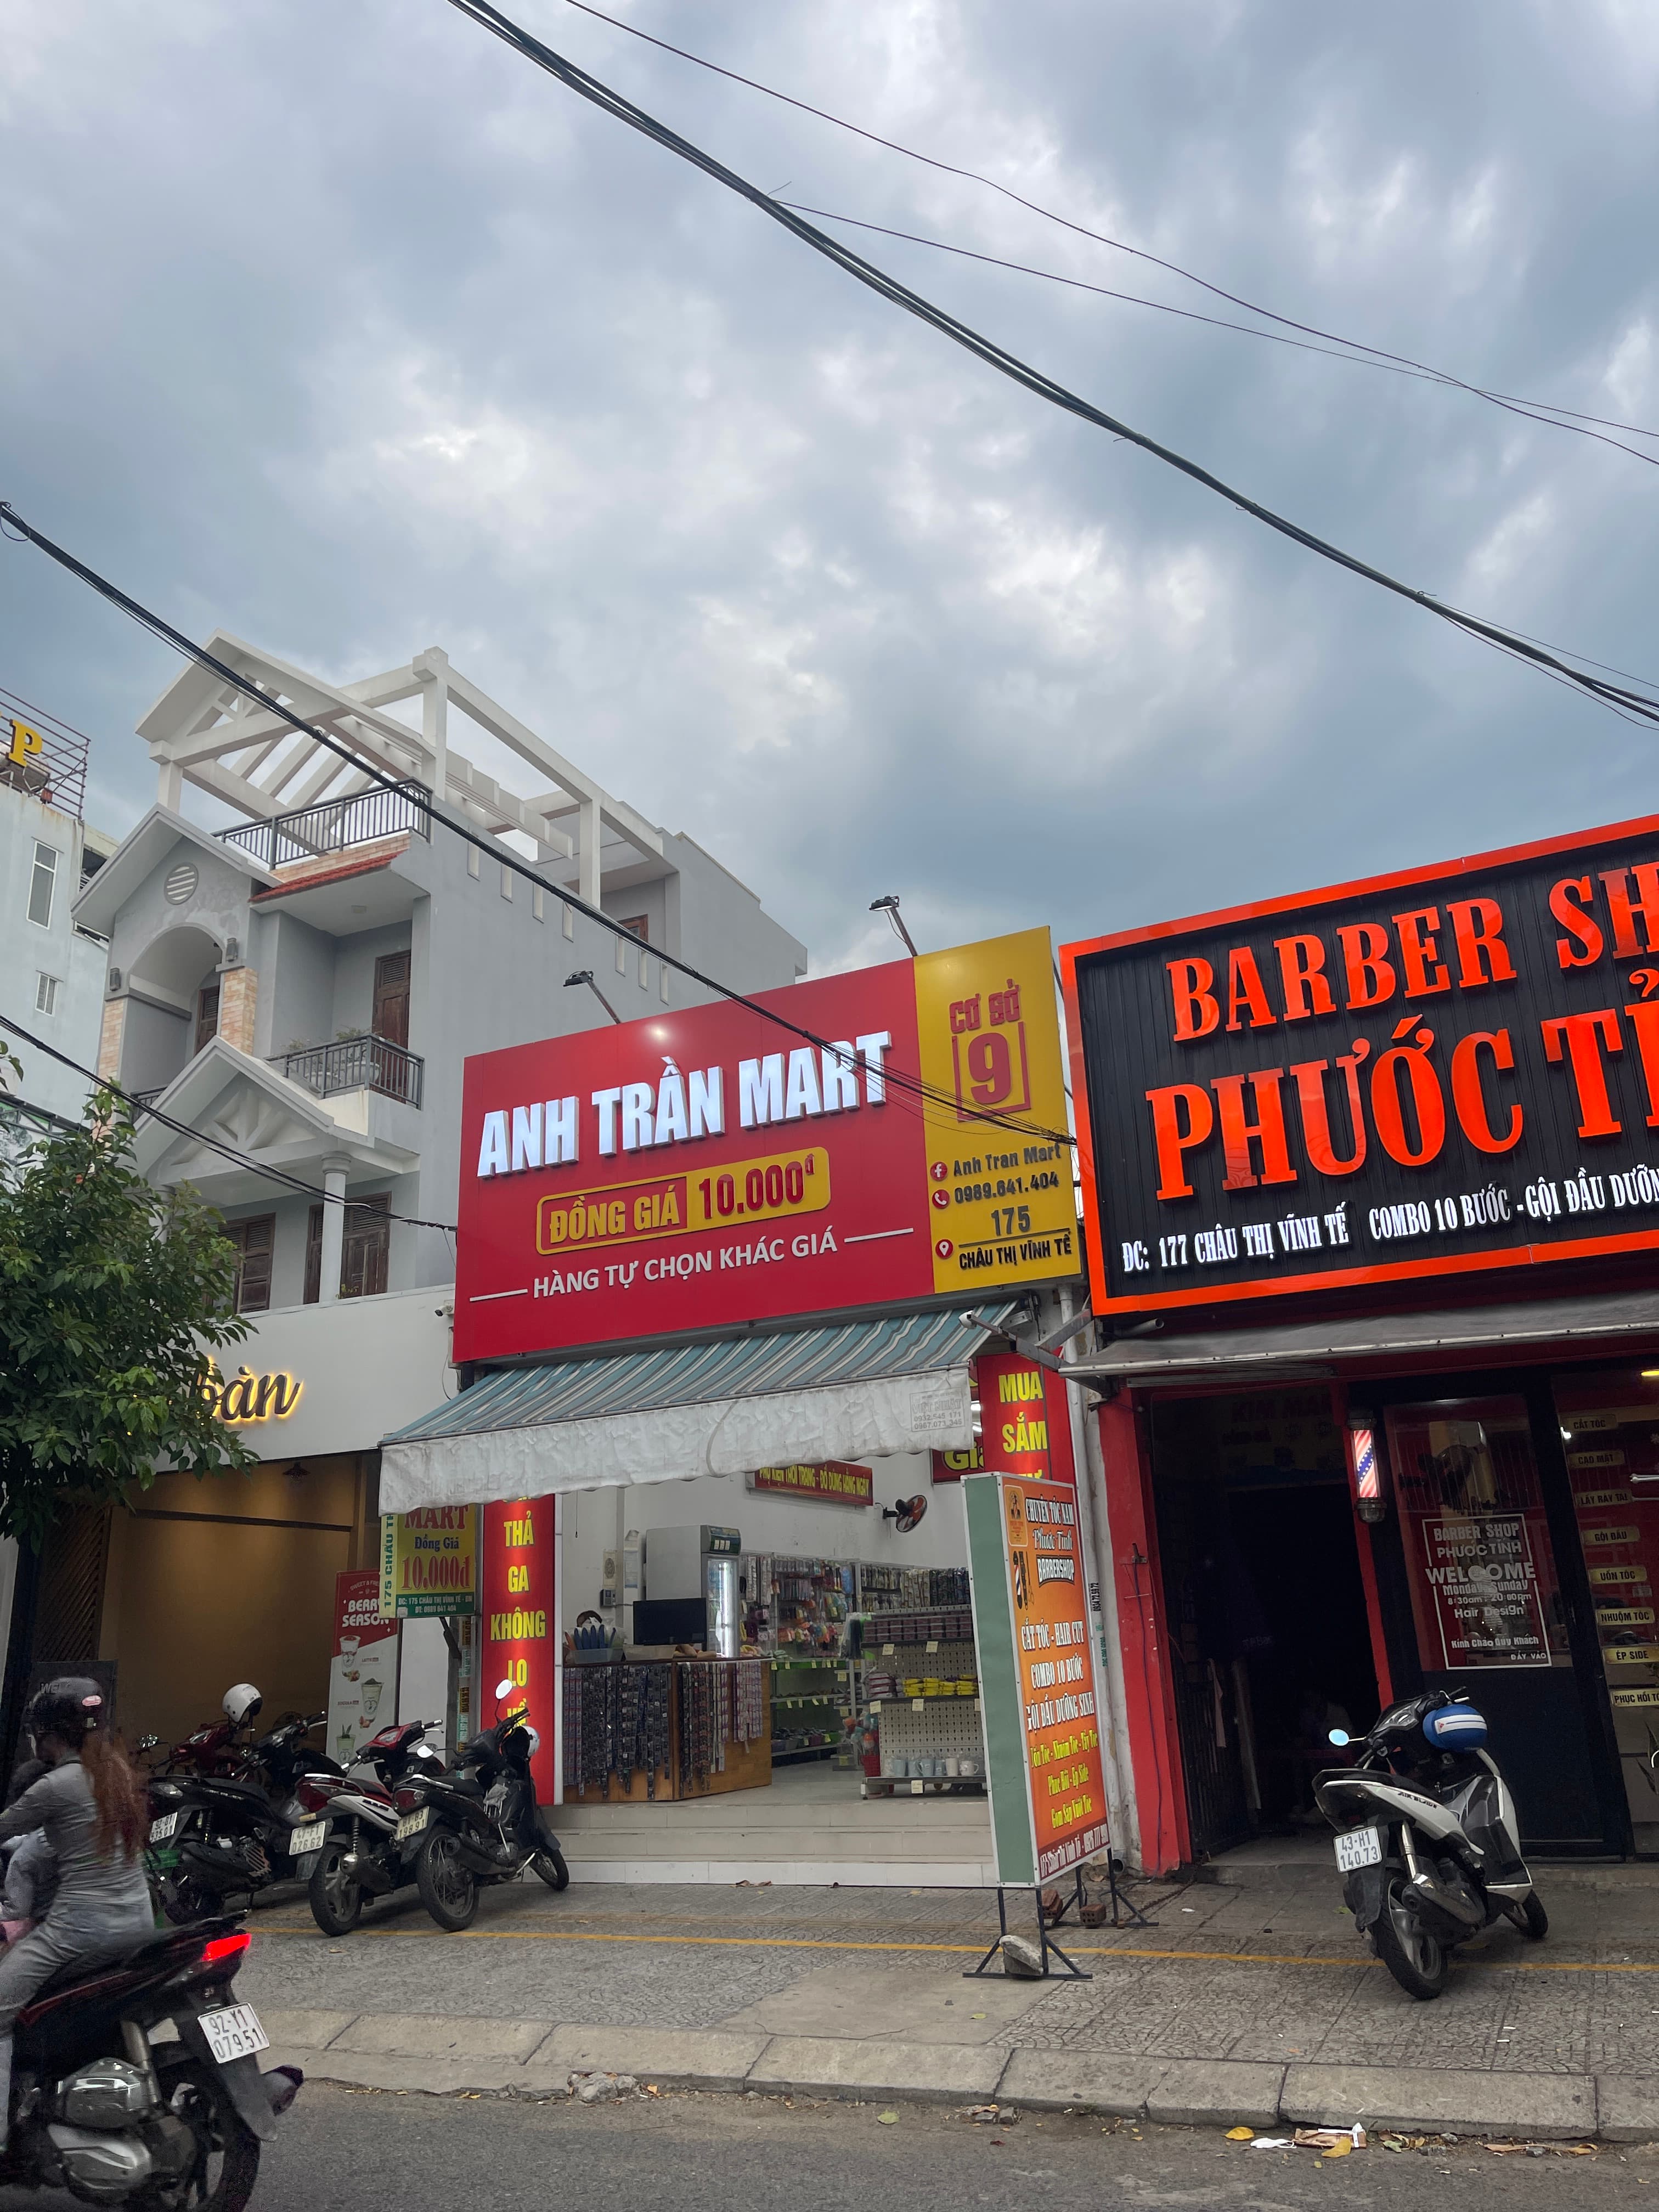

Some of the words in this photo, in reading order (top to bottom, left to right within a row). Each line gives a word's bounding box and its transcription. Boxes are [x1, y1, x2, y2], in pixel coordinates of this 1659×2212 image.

[1166, 898, 1517, 1042] BARBER
[949, 993, 981, 1034] CƠ
[988, 978, 1020, 1026] SỞ
[968, 1032, 1012, 1104] 9
[477, 1096, 579, 1178] ANH
[591, 1056, 725, 1157] TRẦN
[738, 1030, 891, 1129] MART
[1146, 1014, 1523, 1200] PHƯỚC
[953, 1156, 982, 1176] Anh
[985, 1152, 1019, 1171] Tran
[1024, 1142, 1061, 1164] Mart
[955, 1171, 1059, 1204] 0989.641.404
[550, 1195, 625, 1244] ĐỒNG
[634, 1184, 680, 1231] GIÁ
[1369, 1200, 1431, 1240] COMBO
[1434, 1197, 1458, 1231] 10
[1460, 1183, 1510, 1227] BƯỚC
[1526, 1176, 1561, 1223] GỘI
[1564, 1167, 1606, 1213] ĐẦU
[991, 1205, 1031, 1236] 175
[1121, 1240, 1149, 1272] ĐC:
[1159, 1234, 1188, 1267] 177
[1194, 1223, 1238, 1263] CHÂU
[1242, 1223, 1274, 1260] THỊ
[1277, 1213, 1322, 1252] VĨNH
[1325, 1201, 1349, 1245] TẾ
[533, 1269, 599, 1299] HÀNG
[605, 1260, 639, 1289] TỰ
[644, 1250, 712, 1280] CHỌN
[720, 1235, 784, 1269] KHÁC
[792, 1225, 837, 1257] GIÁ
[959, 1247, 993, 1270] CHÂU
[996, 1245, 1018, 1266] THỊ
[1020, 1240, 1051, 1261] VĨNH
[998, 1371, 1043, 1403] MUA
[1002, 1412, 1048, 1453] SẮM
[1590, 1419, 1606, 1428] TÓC
[1578, 1456, 1594, 1466] CẠO
[443, 1536, 459, 1549] Giá
[504, 1510, 534, 1547] THẢ
[1434, 1526, 1481, 1542] BARBER
[1486, 1522, 1519, 1538] SHOP
[1437, 1542, 1488, 1558] PHƯỚC
[507, 1565, 529, 1593] GA
[1037, 1558, 1075, 1583] BARBERSHOP
[1425, 1562, 1536, 1585] WELCOME
[1620, 1567, 1635, 1579] TÓC
[1447, 1596, 1483, 1605] 8:30am
[1491, 1579, 1528, 1593] Sunday
[490, 1606, 546, 1641] KHÔNG
[1454, 1609, 1480, 1618] Hair
[1485, 1605, 1524, 1616] Design
[1601, 1610, 1632, 1624] NHUỘM
[1633, 1607, 1650, 1621] TÓC
[1021, 1617, 1036, 1650] CẮT
[1036, 1618, 1051, 1648] TÓC
[1054, 1622, 1072, 1646] HAIR
[1071, 1621, 1084, 1644] CUT
[1452, 1639, 1470, 1649] Kính
[1514, 1634, 1539, 1645] Khách
[1616, 1649, 1627, 1661] ÉP
[1629, 1650, 1649, 1660] SIDE
[507, 1658, 528, 1687] LO
[1031, 1661, 1056, 1689] COMBO
[1057, 1659, 1066, 1684] 10
[1066, 1652, 1084, 1682] BƯỚC
[1040, 1693, 1056, 1728] ĐẦU
[1056, 1692, 1078, 1723] DƯỠNG
[1079, 1691, 1094, 1717] SINH
[1614, 1695, 1635, 1705] PHỤC
[399, 1819, 425, 1838] 198.91
[1340, 1846, 1378, 1869] 140.73
[213, 2028, 262, 2058] 079.51
